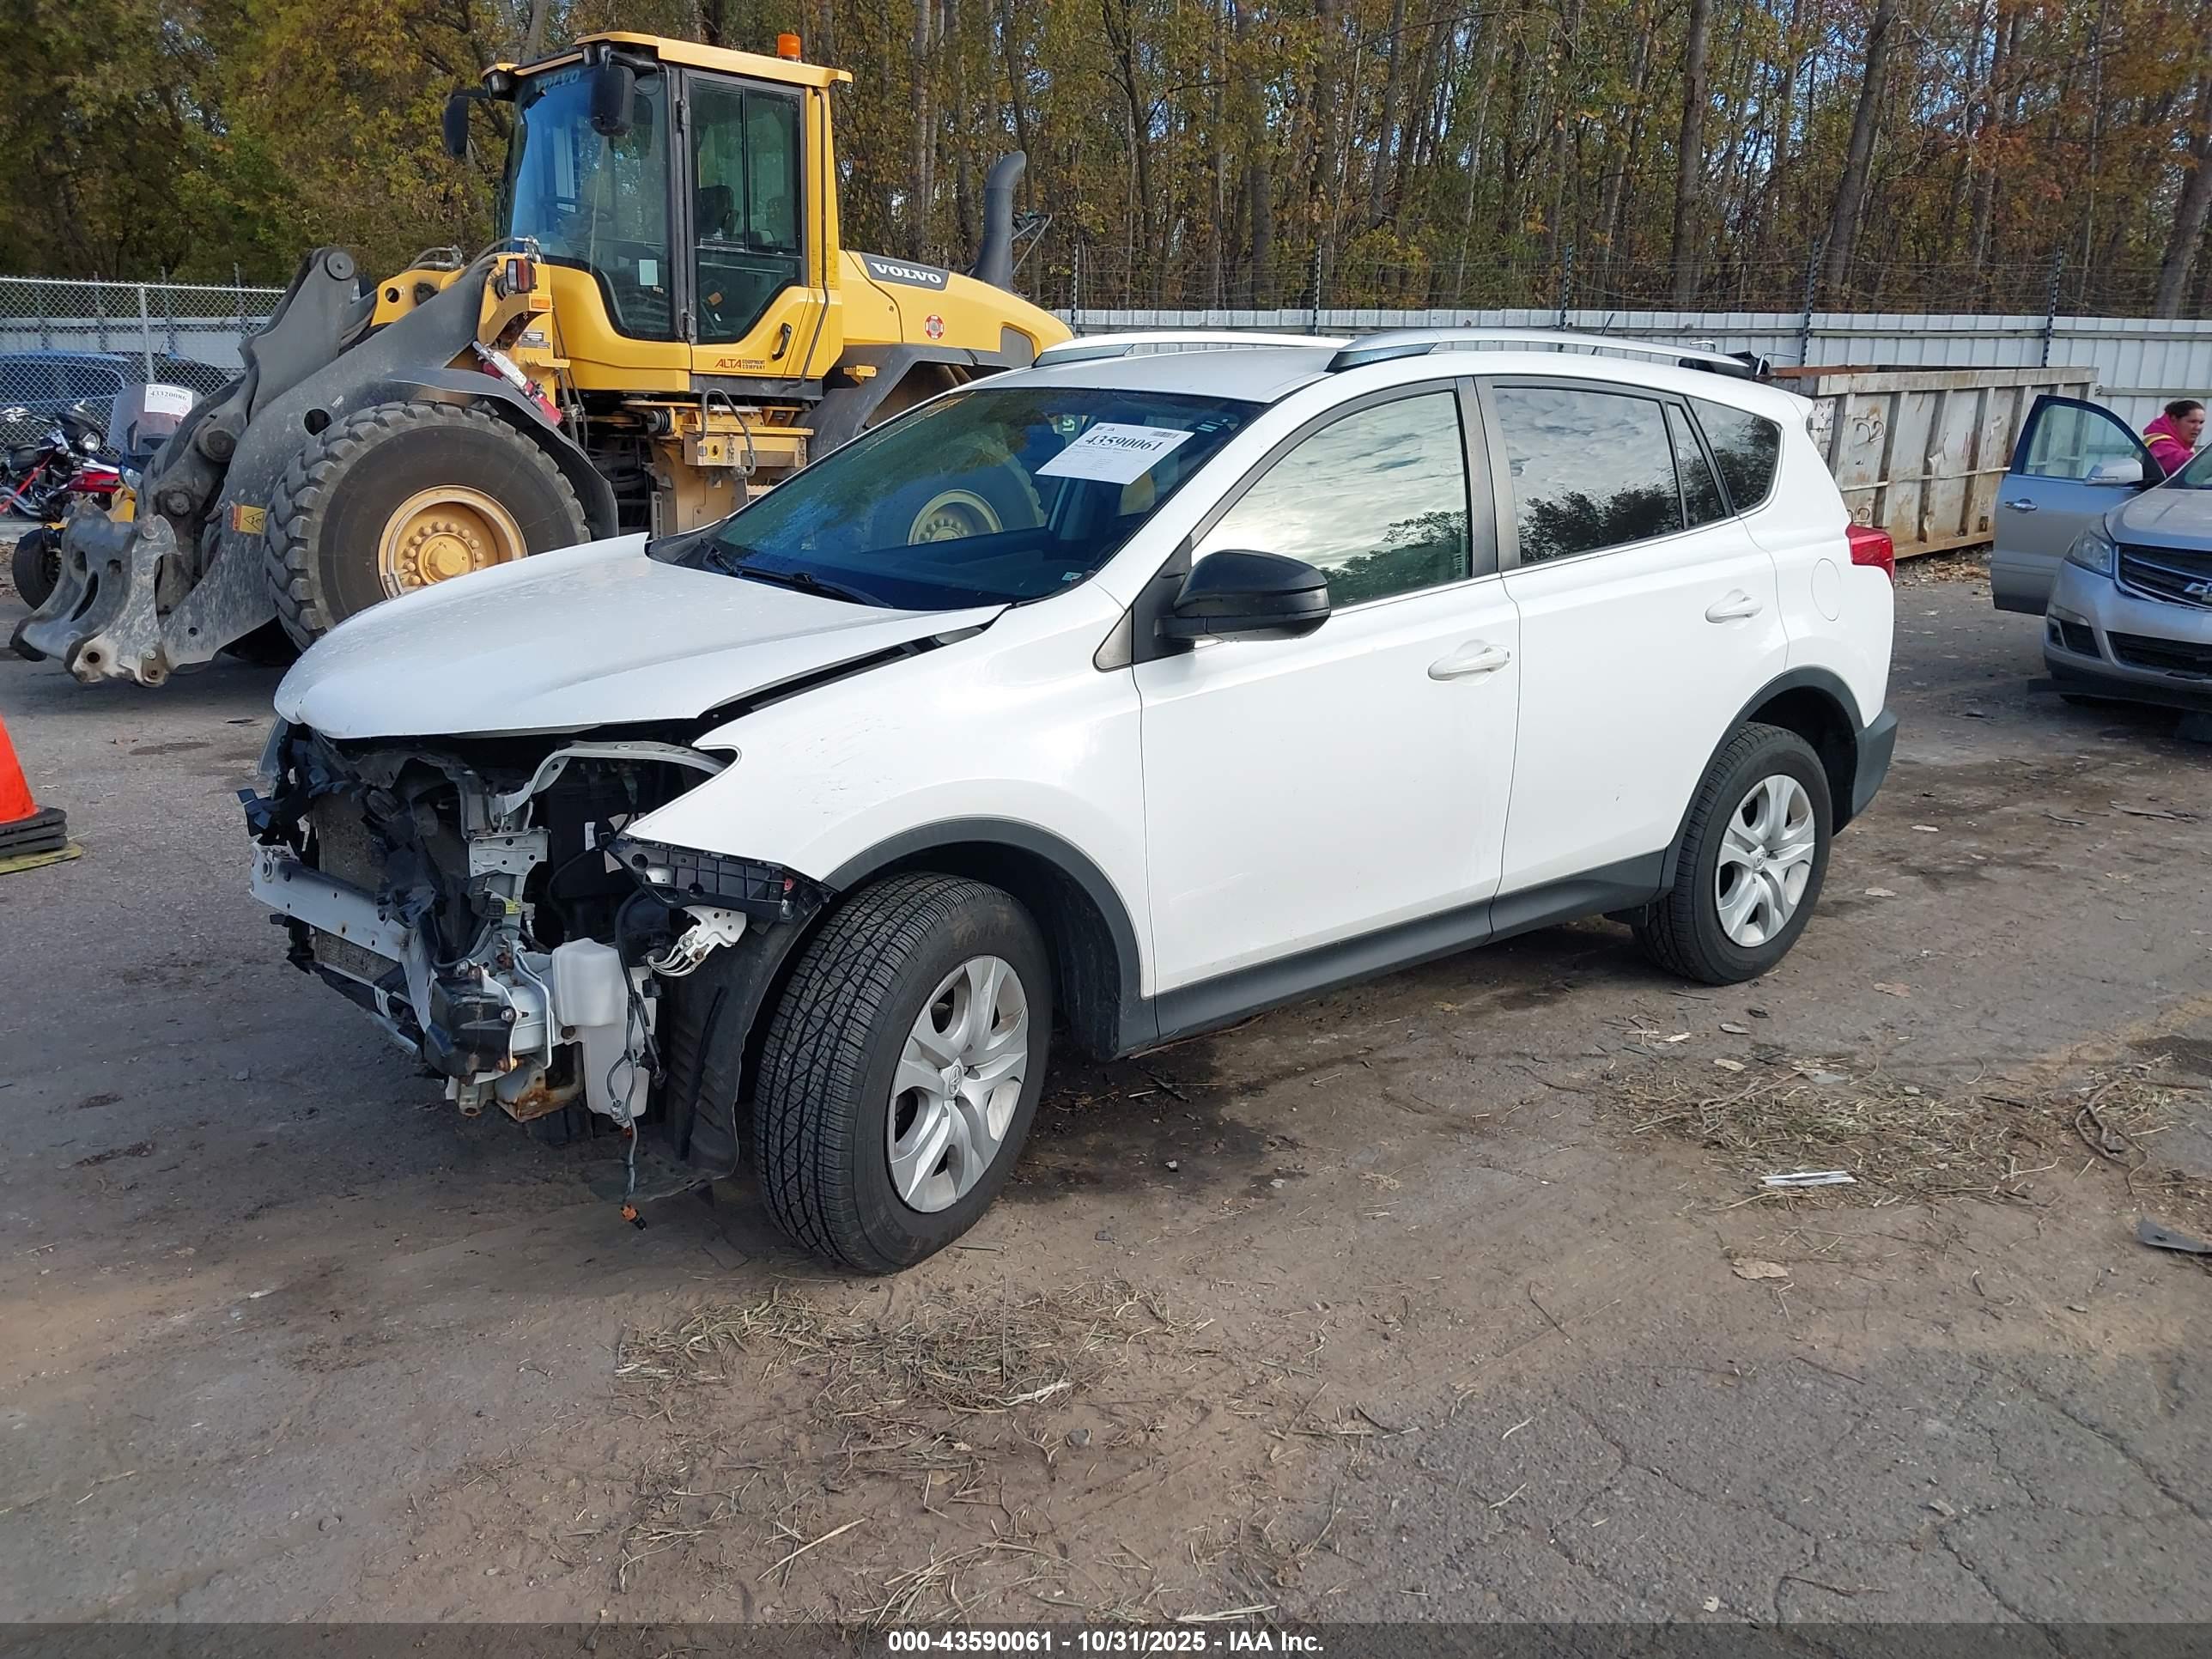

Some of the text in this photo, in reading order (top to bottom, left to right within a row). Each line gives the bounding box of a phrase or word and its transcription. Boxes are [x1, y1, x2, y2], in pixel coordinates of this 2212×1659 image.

[870, 262, 941, 284] VOLVO
[714, 358, 742, 368] ALTA
[1085, 434, 1164, 452] 43590061
